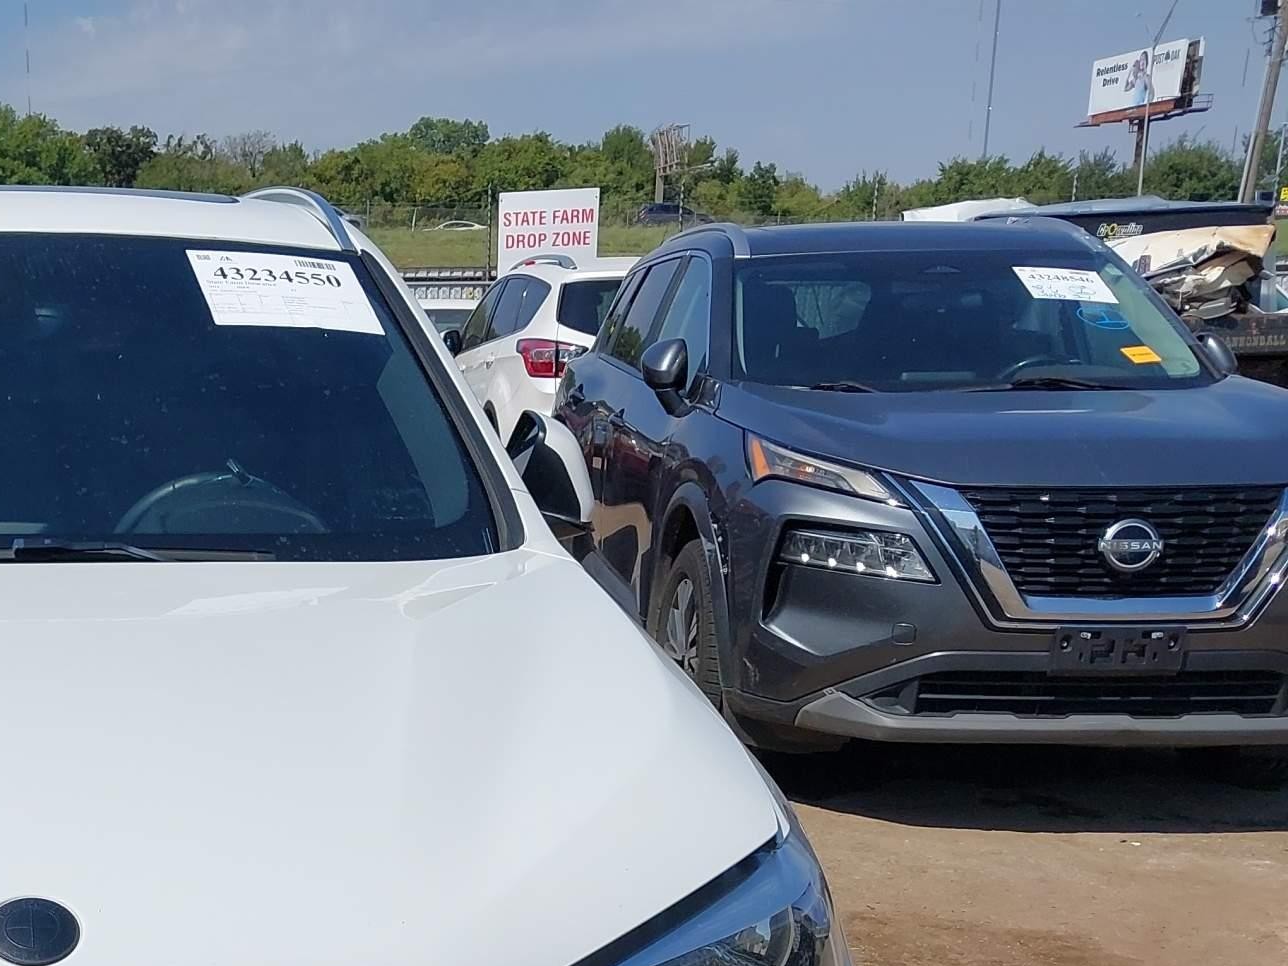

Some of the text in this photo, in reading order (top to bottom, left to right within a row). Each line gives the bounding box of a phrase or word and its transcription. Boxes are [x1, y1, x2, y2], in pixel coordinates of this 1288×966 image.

[1096, 62, 1128, 76] Relentless
[1102, 76, 1119, 87] Drive
[503, 208, 595, 227] STATE FARM
[505, 230, 591, 249] DROP ZONE
[213, 266, 342, 288] 43234550
[1100, 541, 1162, 550] NISSAN
